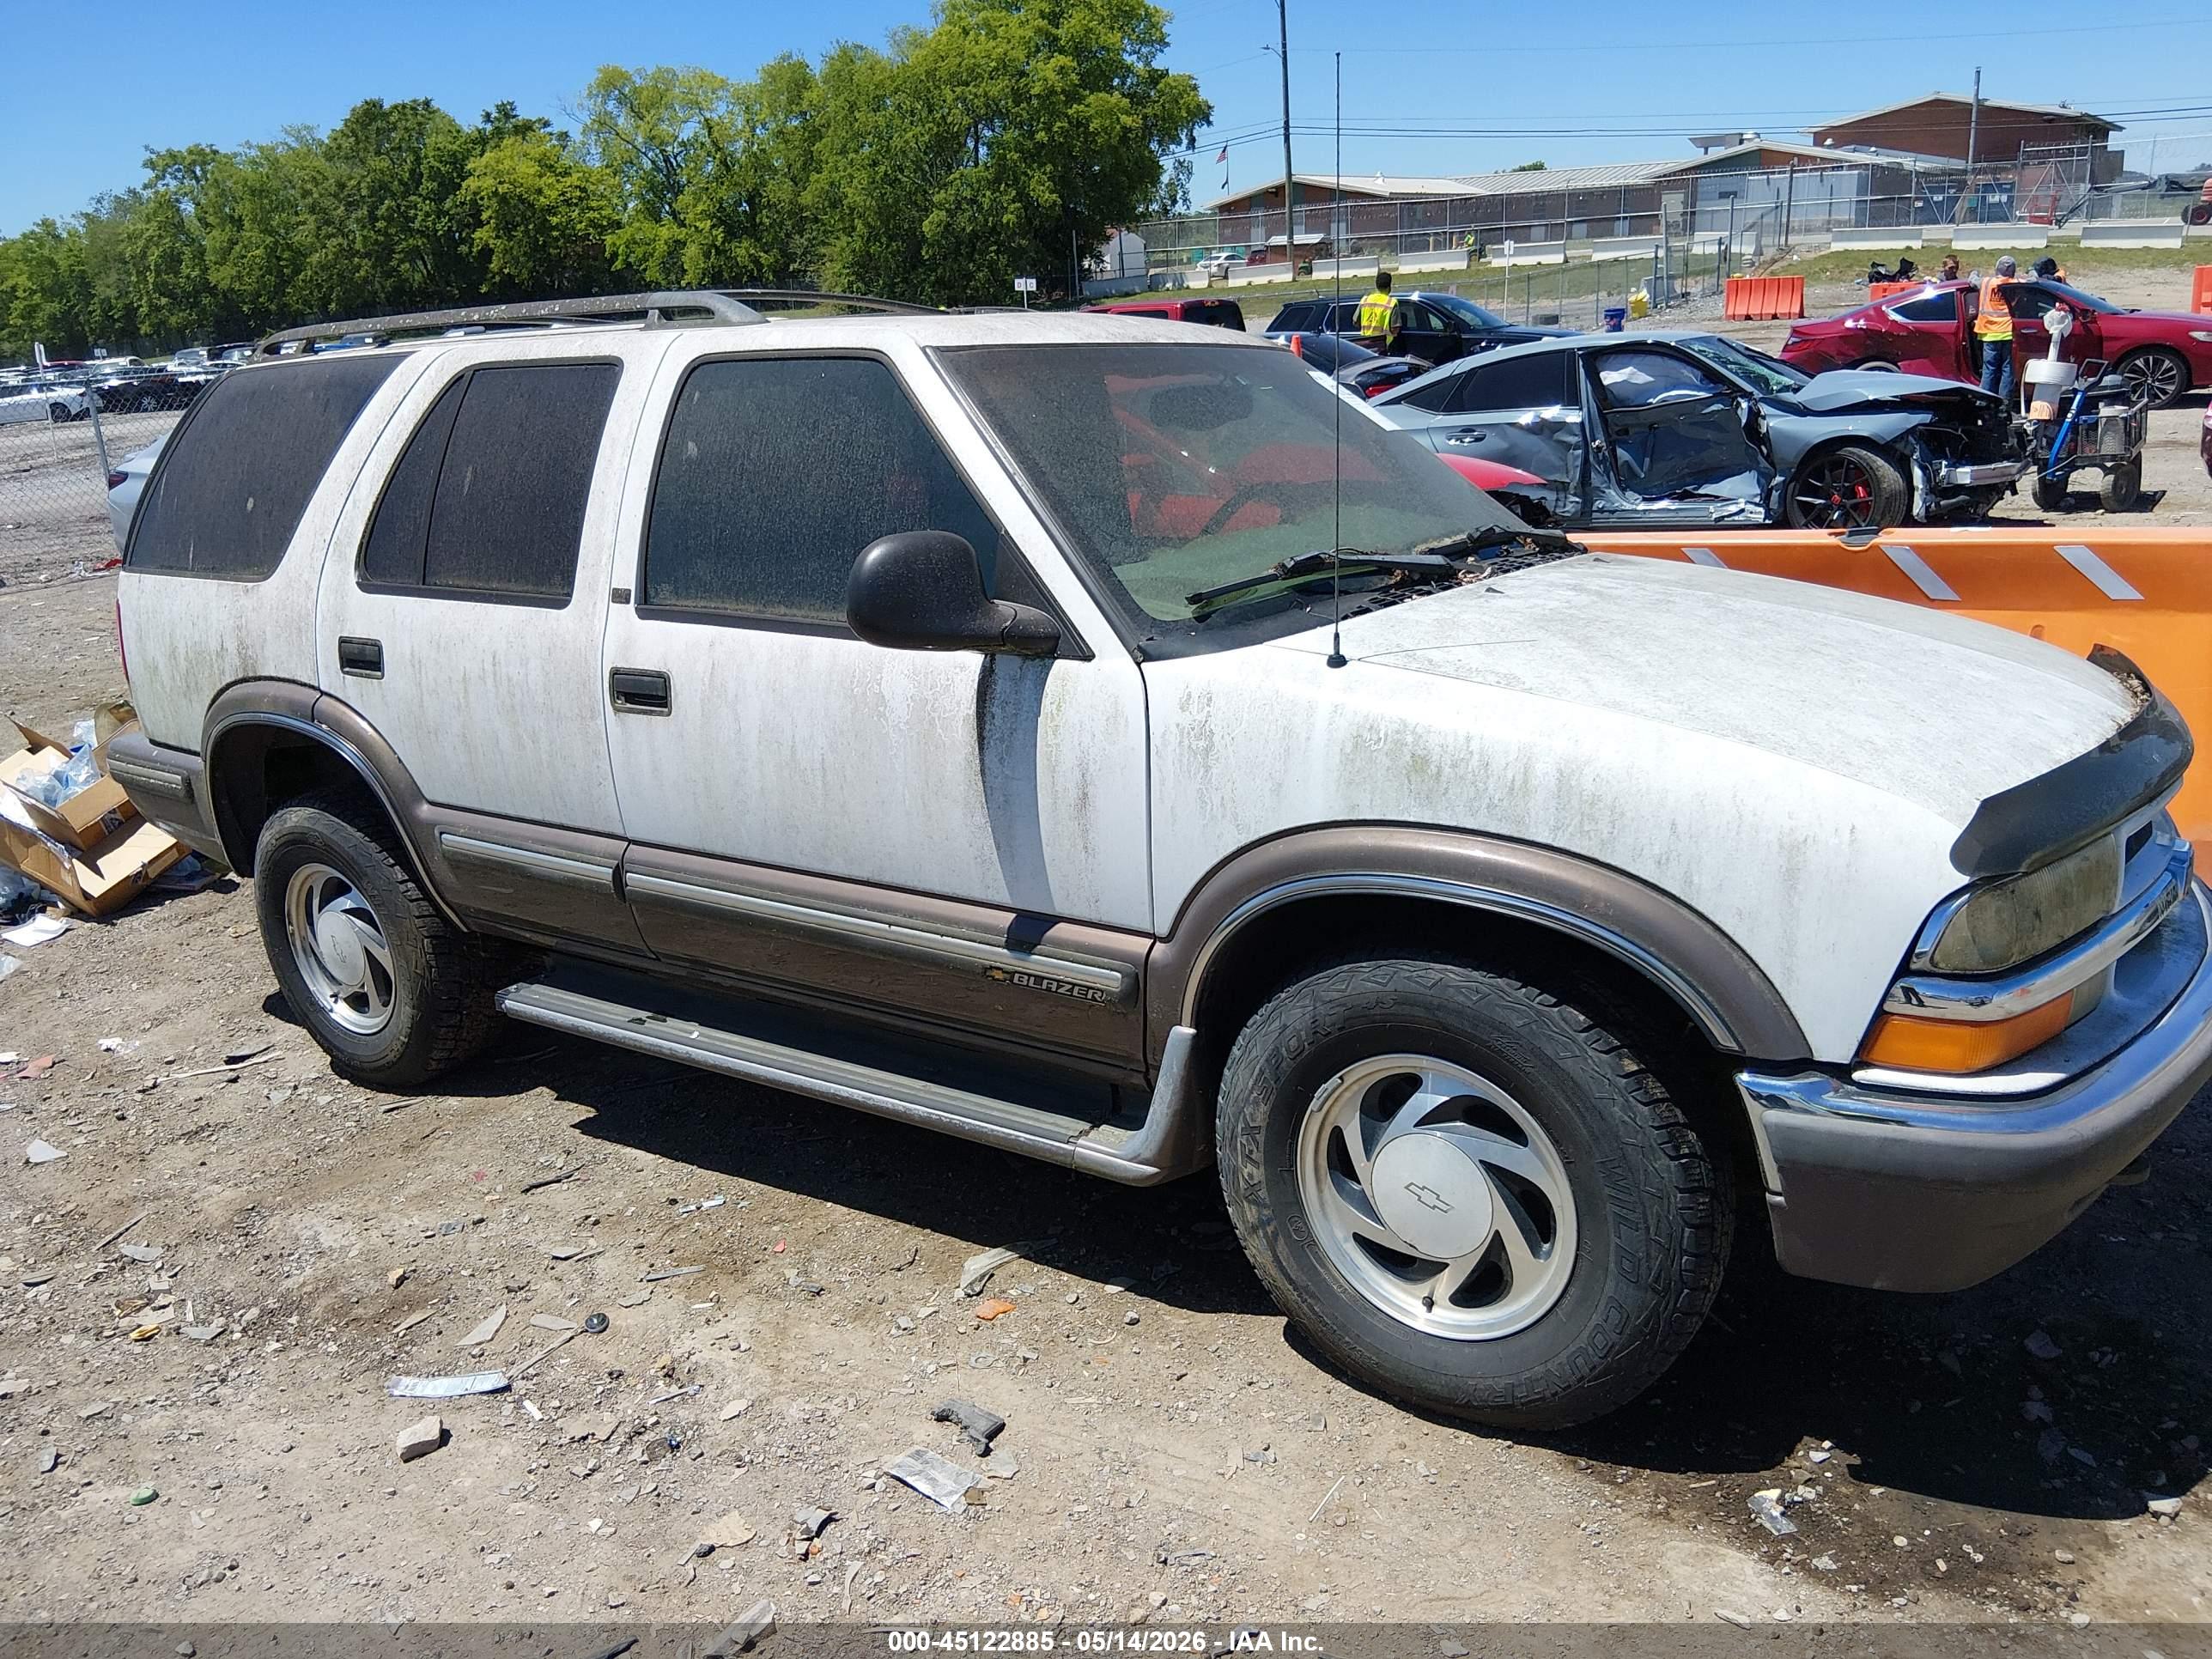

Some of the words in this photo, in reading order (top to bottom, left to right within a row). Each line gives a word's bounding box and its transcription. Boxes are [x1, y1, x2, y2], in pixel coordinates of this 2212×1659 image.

[1012, 972, 1105, 1003] BLAZER
[1253, 1003, 1353, 1107] SPORT
[1595, 1155, 1642, 1284] WILD
[1456, 1294, 1630, 1407] COUNTRY
